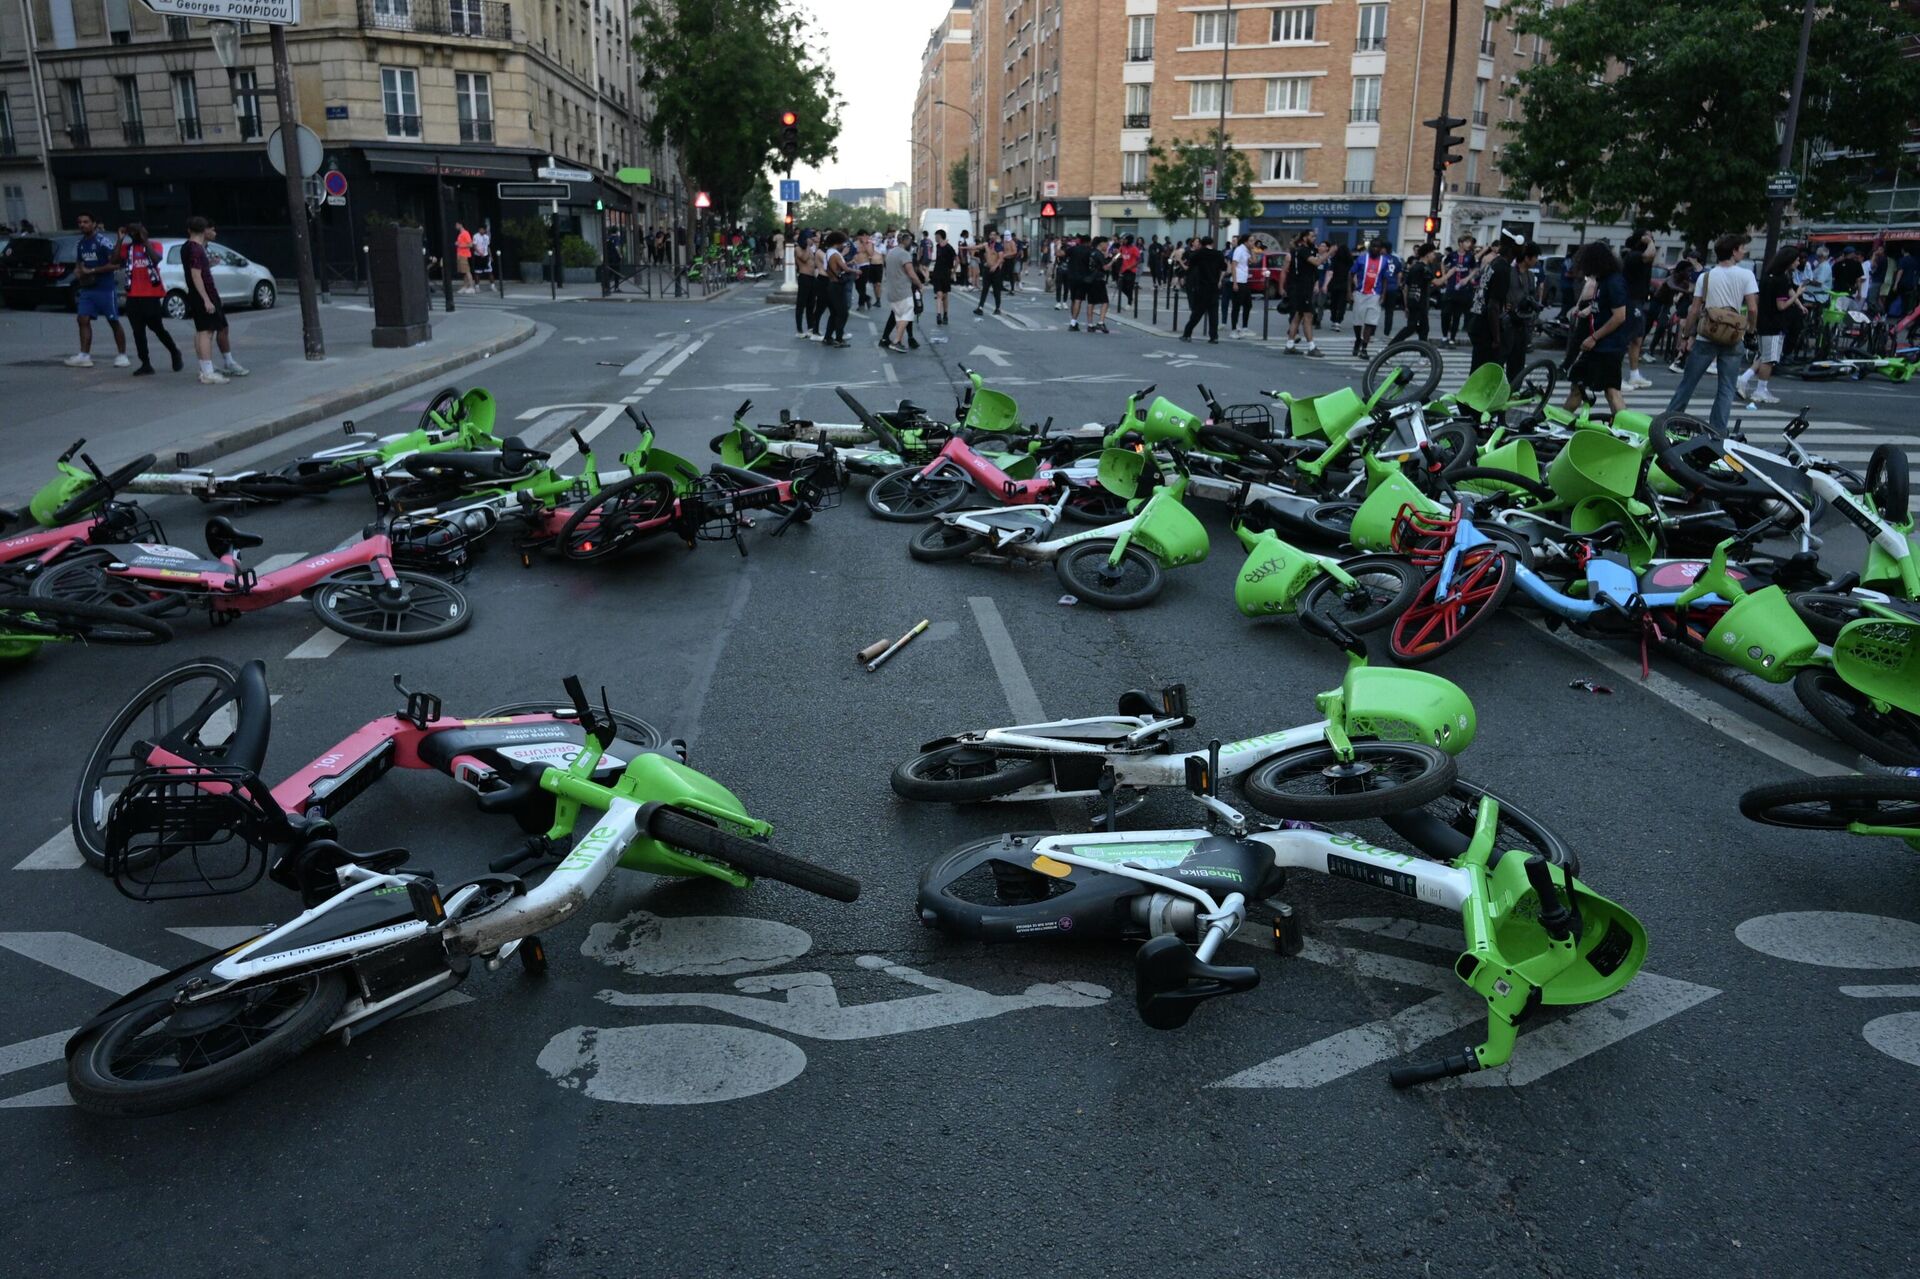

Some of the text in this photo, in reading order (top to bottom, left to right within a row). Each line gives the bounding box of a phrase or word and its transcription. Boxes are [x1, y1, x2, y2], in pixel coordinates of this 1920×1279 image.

[177, 0, 287, 18] Georges POMPIDOU
[1289, 203, 1350, 211] ROC-ECLERC
[306, 557, 335, 568] voi.
[514, 745, 576, 758] GRATUITS
[530, 754, 559, 762] trajets
[313, 754, 344, 768] voi.
[1179, 869, 1243, 883] LimeBike
[264, 954, 286, 962] On
[289, 944, 326, 957] Lime
[341, 931, 377, 944] Uber
[382, 920, 420, 935] Apps
